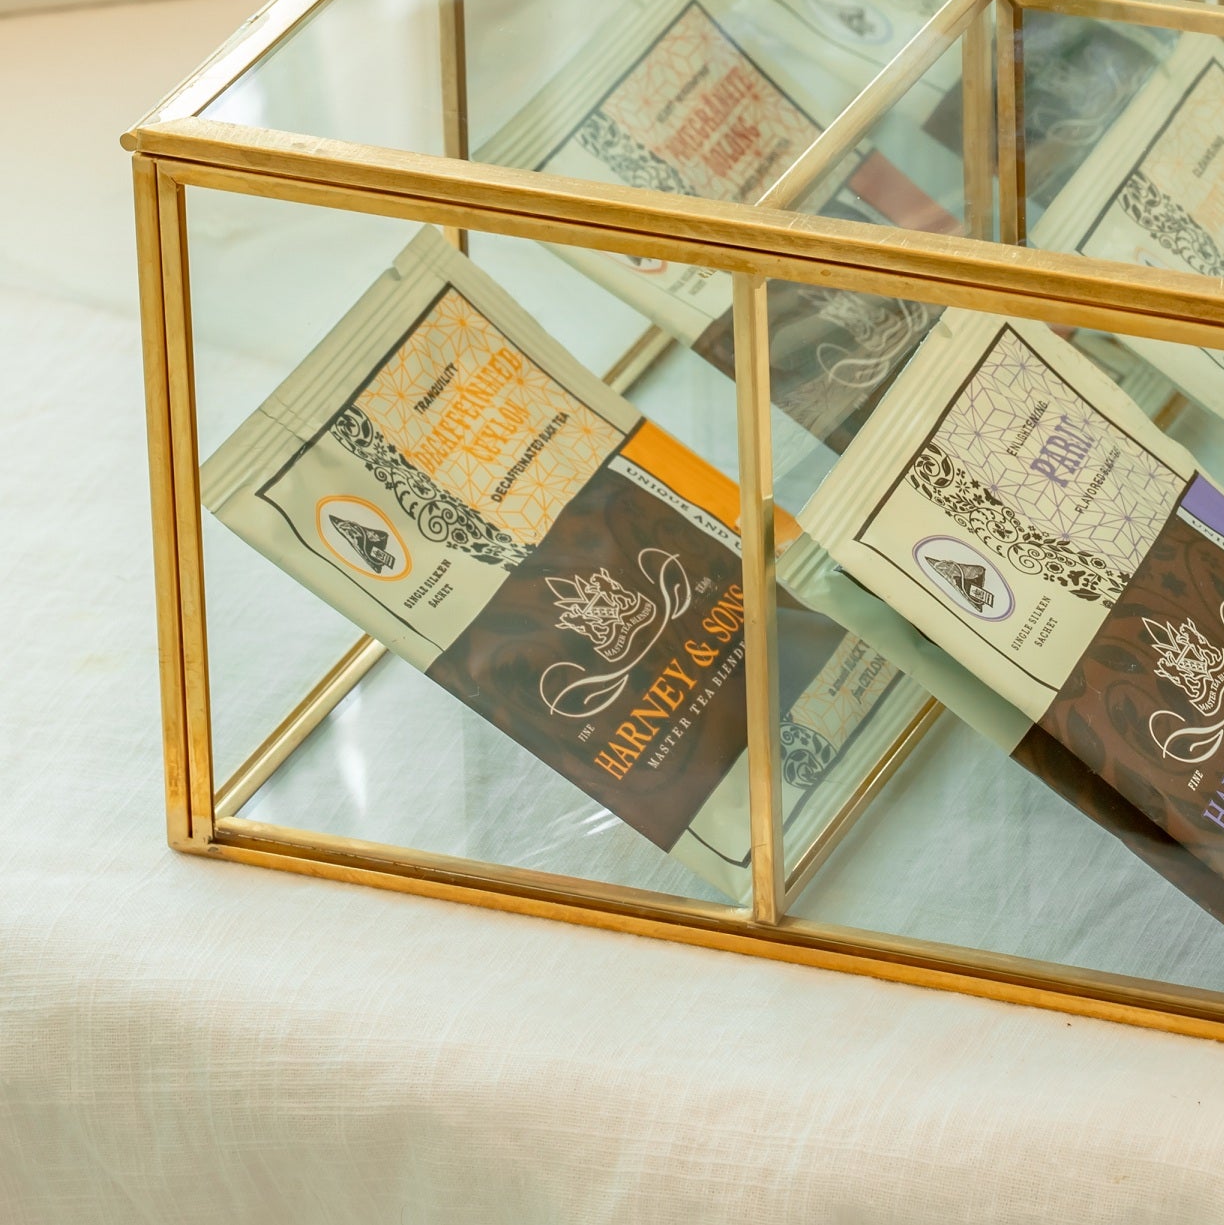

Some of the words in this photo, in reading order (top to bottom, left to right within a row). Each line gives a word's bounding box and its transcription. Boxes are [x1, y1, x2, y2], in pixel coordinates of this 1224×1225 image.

[413, 362, 459, 415] TRANQUILITY
[413, 347, 523, 475] DECAFFEINATED
[1006, 400, 1049, 457] ENLIGHTENING
[490, 438, 545, 503] DECAFFEINATED
[551, 411, 570, 429] TEA
[626, 466, 689, 512] UNIQUE
[694, 514, 729, 539] AND
[404, 586, 429, 609] SINGLE
[424, 559, 452, 588] SILKEN
[428, 583, 453, 608] SACHET
[603, 634, 627, 657] MASTER
[620, 622, 633, 635] TEA
[1011, 624, 1033, 651] SINGLE
[1028, 595, 1051, 625] SILKEN
[1034, 616, 1058, 647] SACHET
[594, 658, 698, 780] HARNEY
[684, 640, 719, 667] &
[647, 717, 692, 769] MASTER
[690, 688, 715, 716] TEA
[712, 639, 746, 688] BLENDE
[1198, 690, 1217, 711] MASTER
[1211, 678, 1222, 692] TEA
[578, 723, 596, 743] FINE
[1187, 768, 1204, 791] FINE
